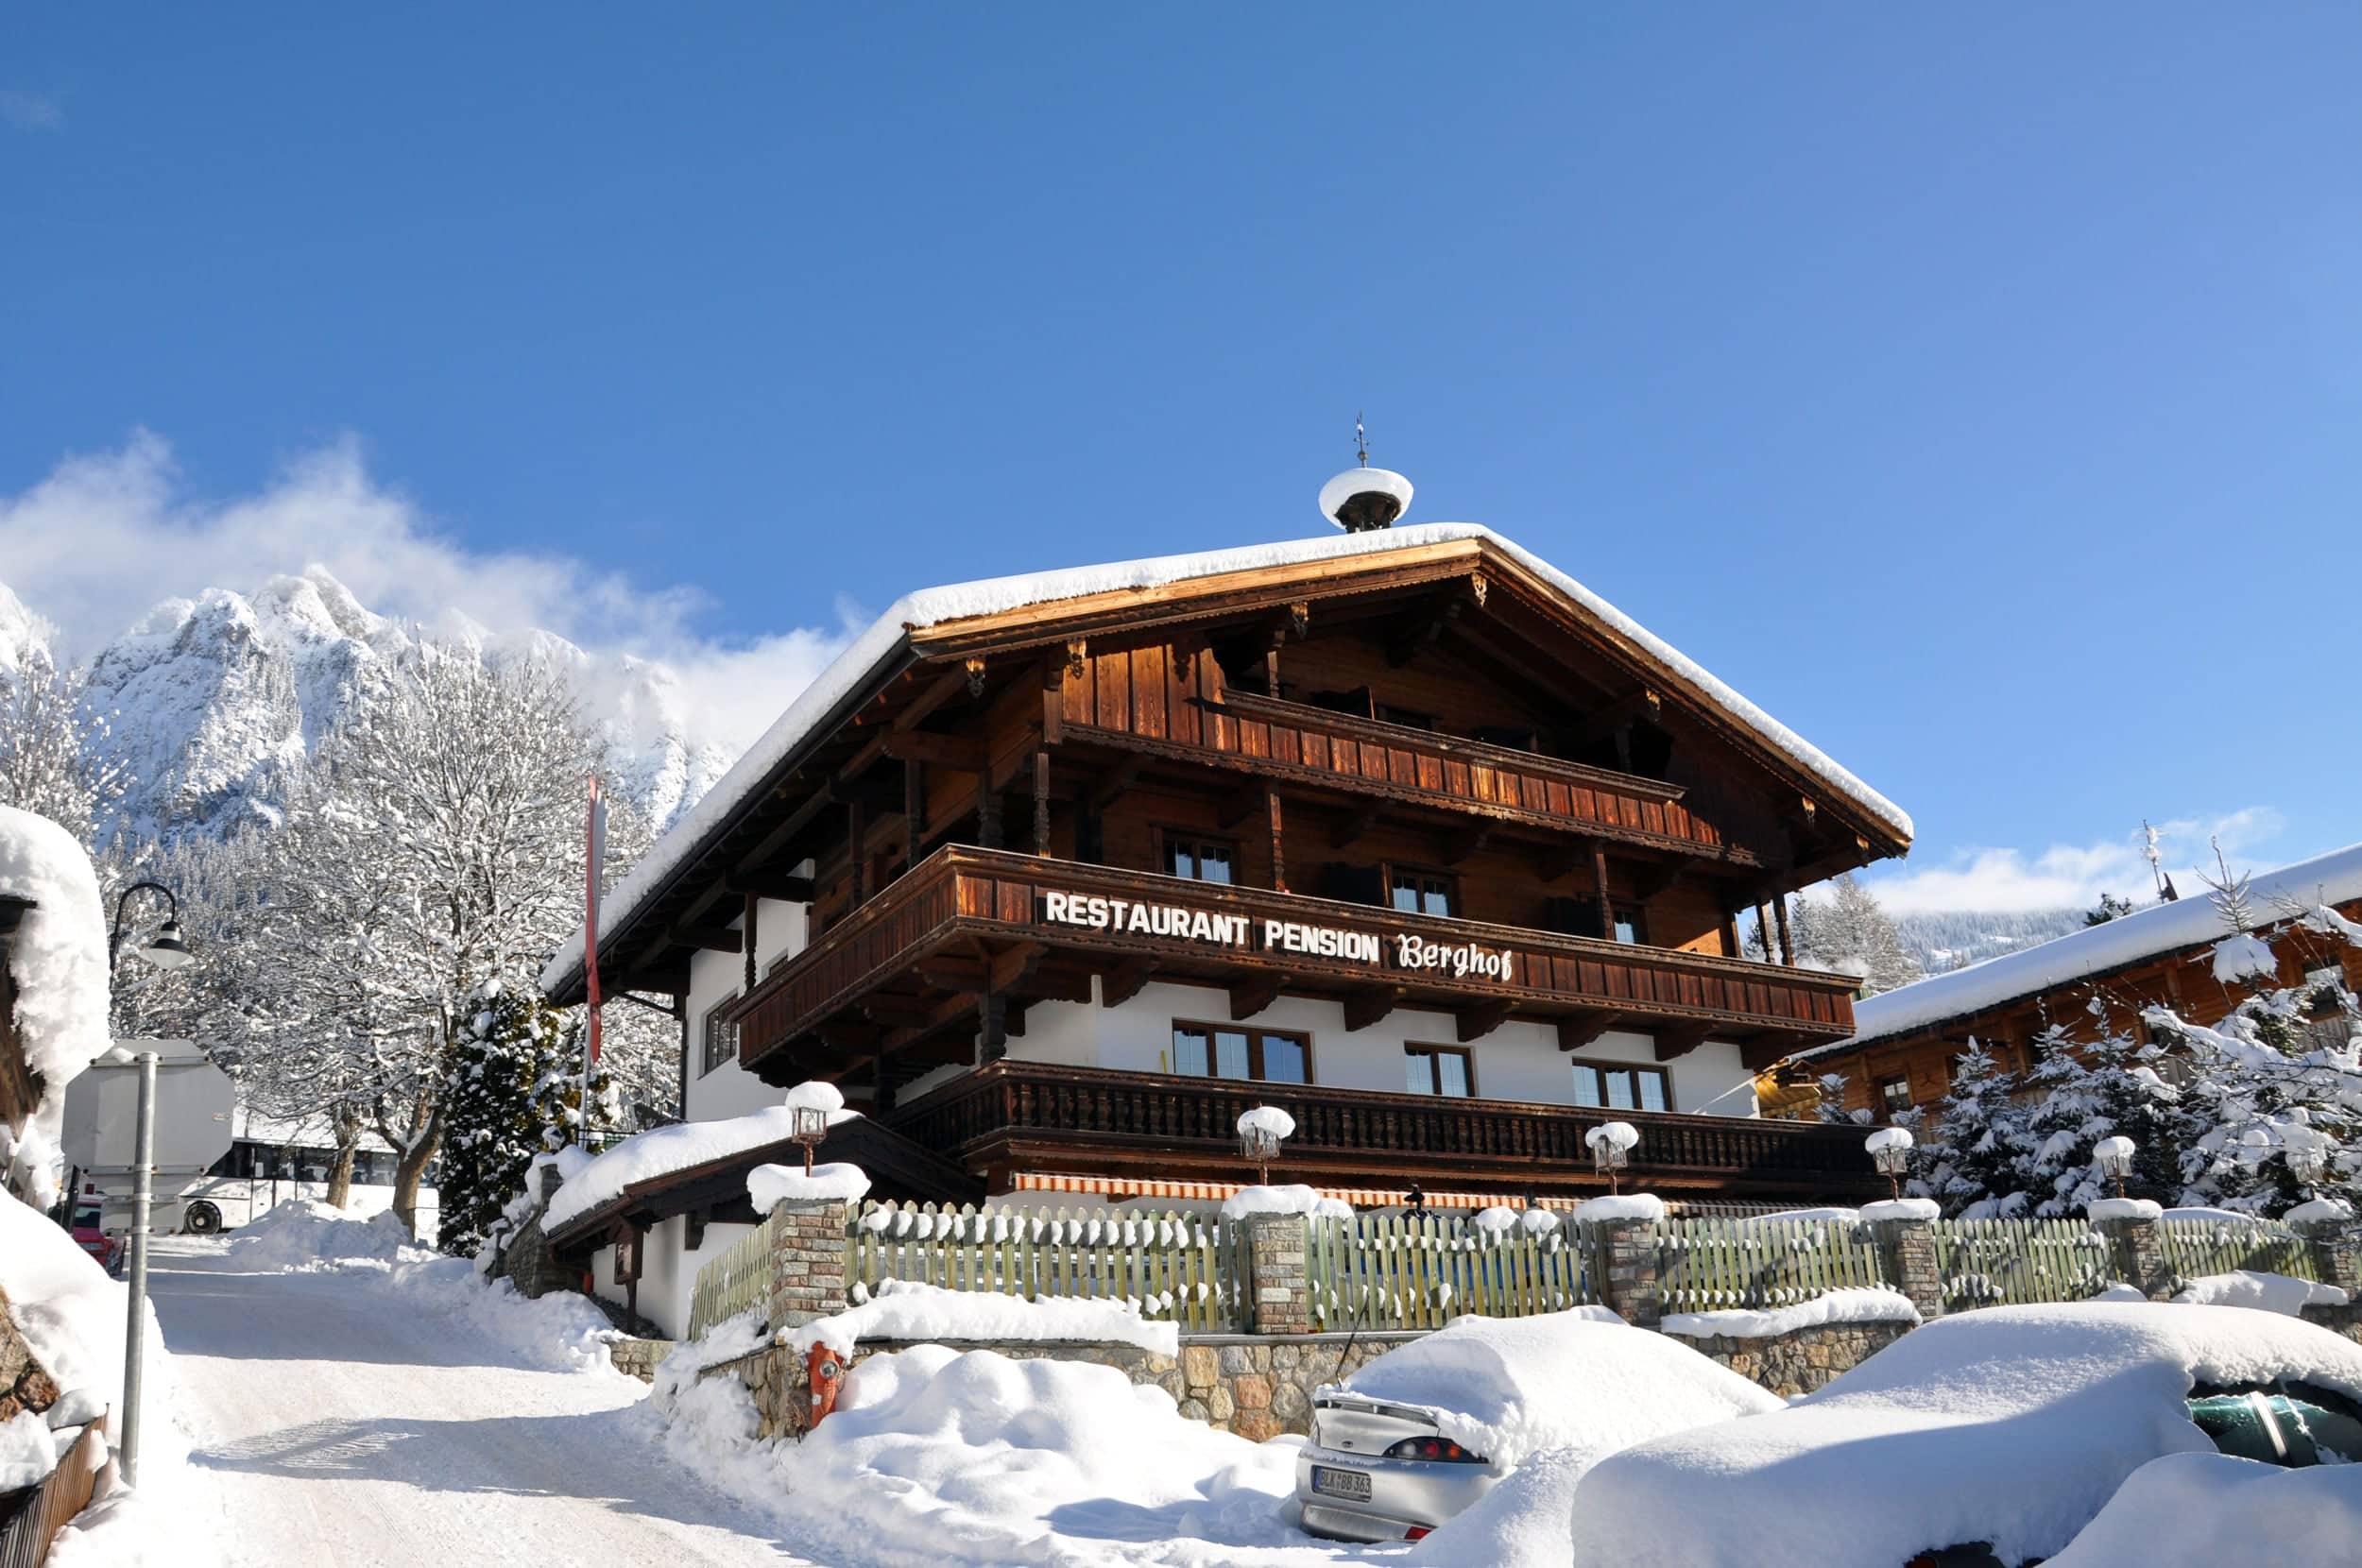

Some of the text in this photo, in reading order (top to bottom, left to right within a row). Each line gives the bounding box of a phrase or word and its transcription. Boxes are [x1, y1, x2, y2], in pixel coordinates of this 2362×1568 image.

[1046, 891, 1514, 981] RESTAURANT PENSION Berghof
